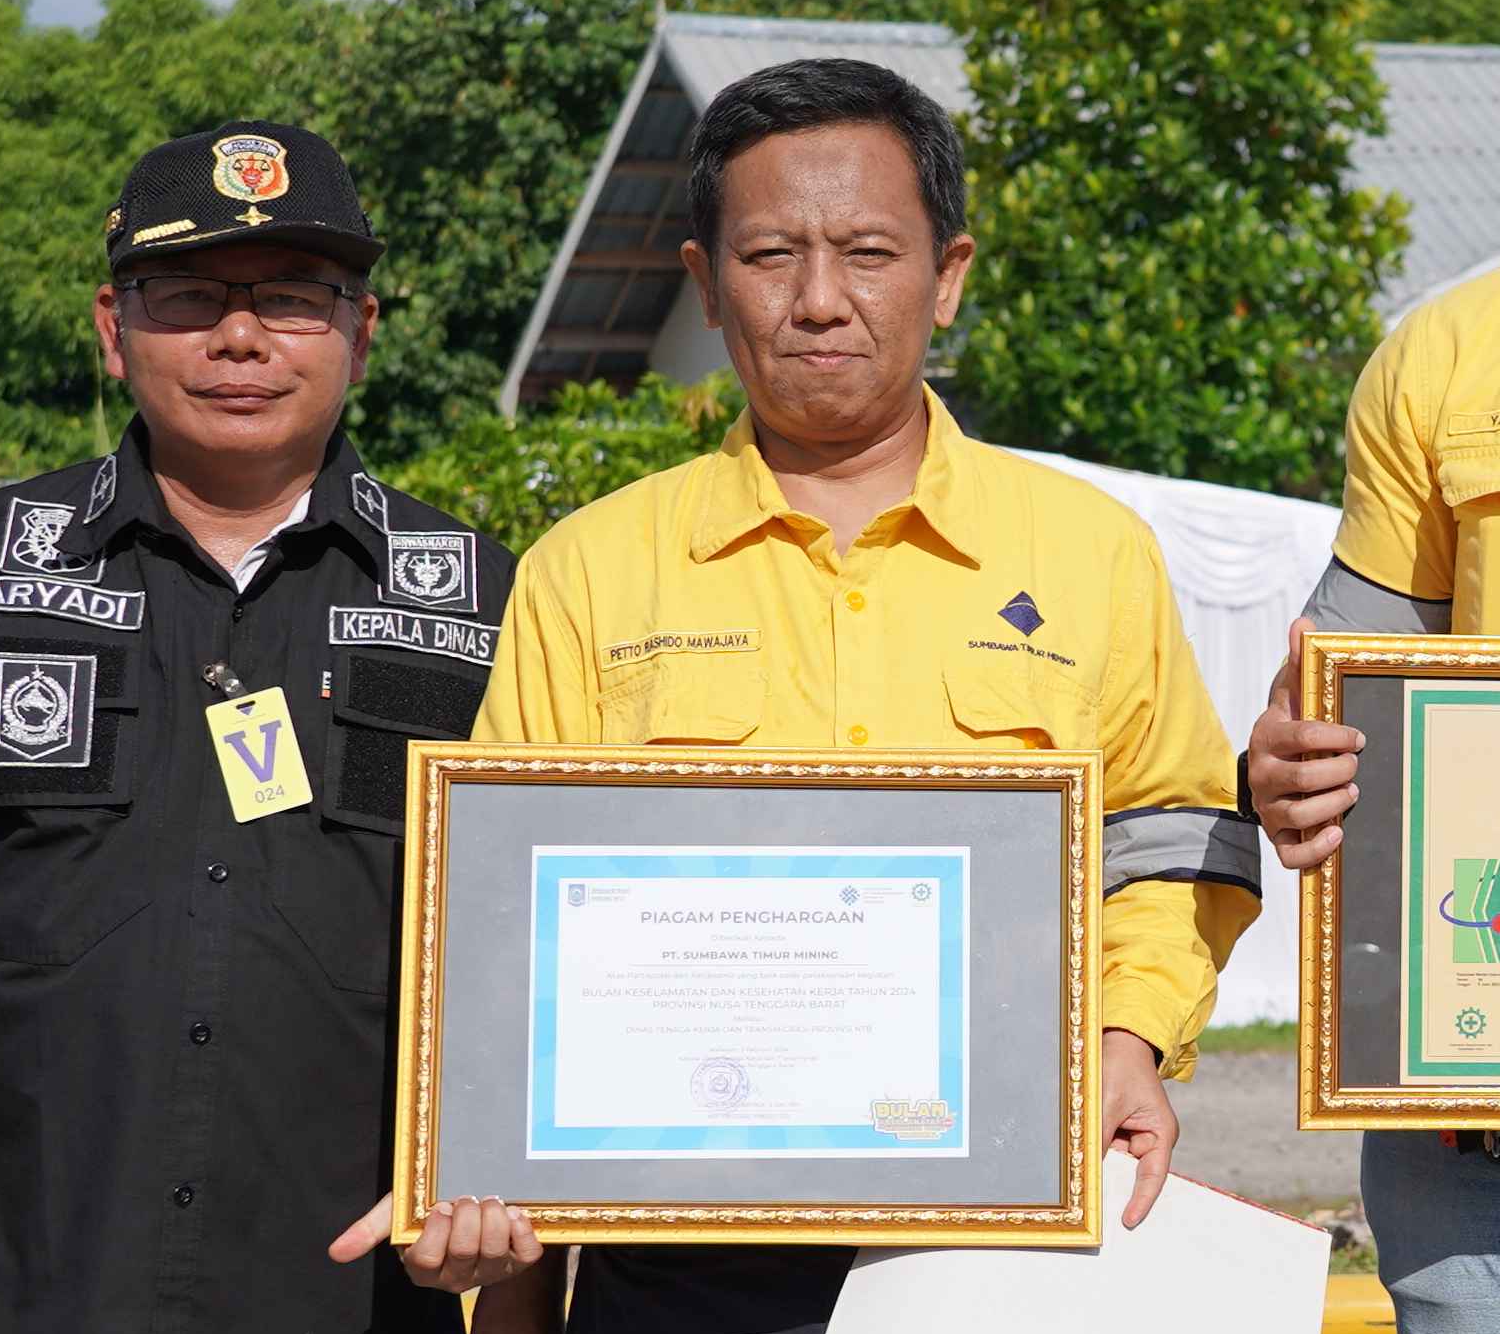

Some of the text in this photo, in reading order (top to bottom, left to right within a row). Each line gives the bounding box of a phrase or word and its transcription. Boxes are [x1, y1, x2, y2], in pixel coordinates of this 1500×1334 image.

[342, 613, 491, 658] KEPALA DINAS
[610, 644, 642, 661] PETTO
[687, 634, 749, 648] MAWAJAYA
[223, 719, 282, 783] V
[255, 784, 284, 803] 024
[640, 911, 865, 924] PIAGAM PENGHARGAAN
[662, 951, 839, 960] PT. SUMBAWA TIMUR MINING
[874, 1102, 945, 1118] BULAN
